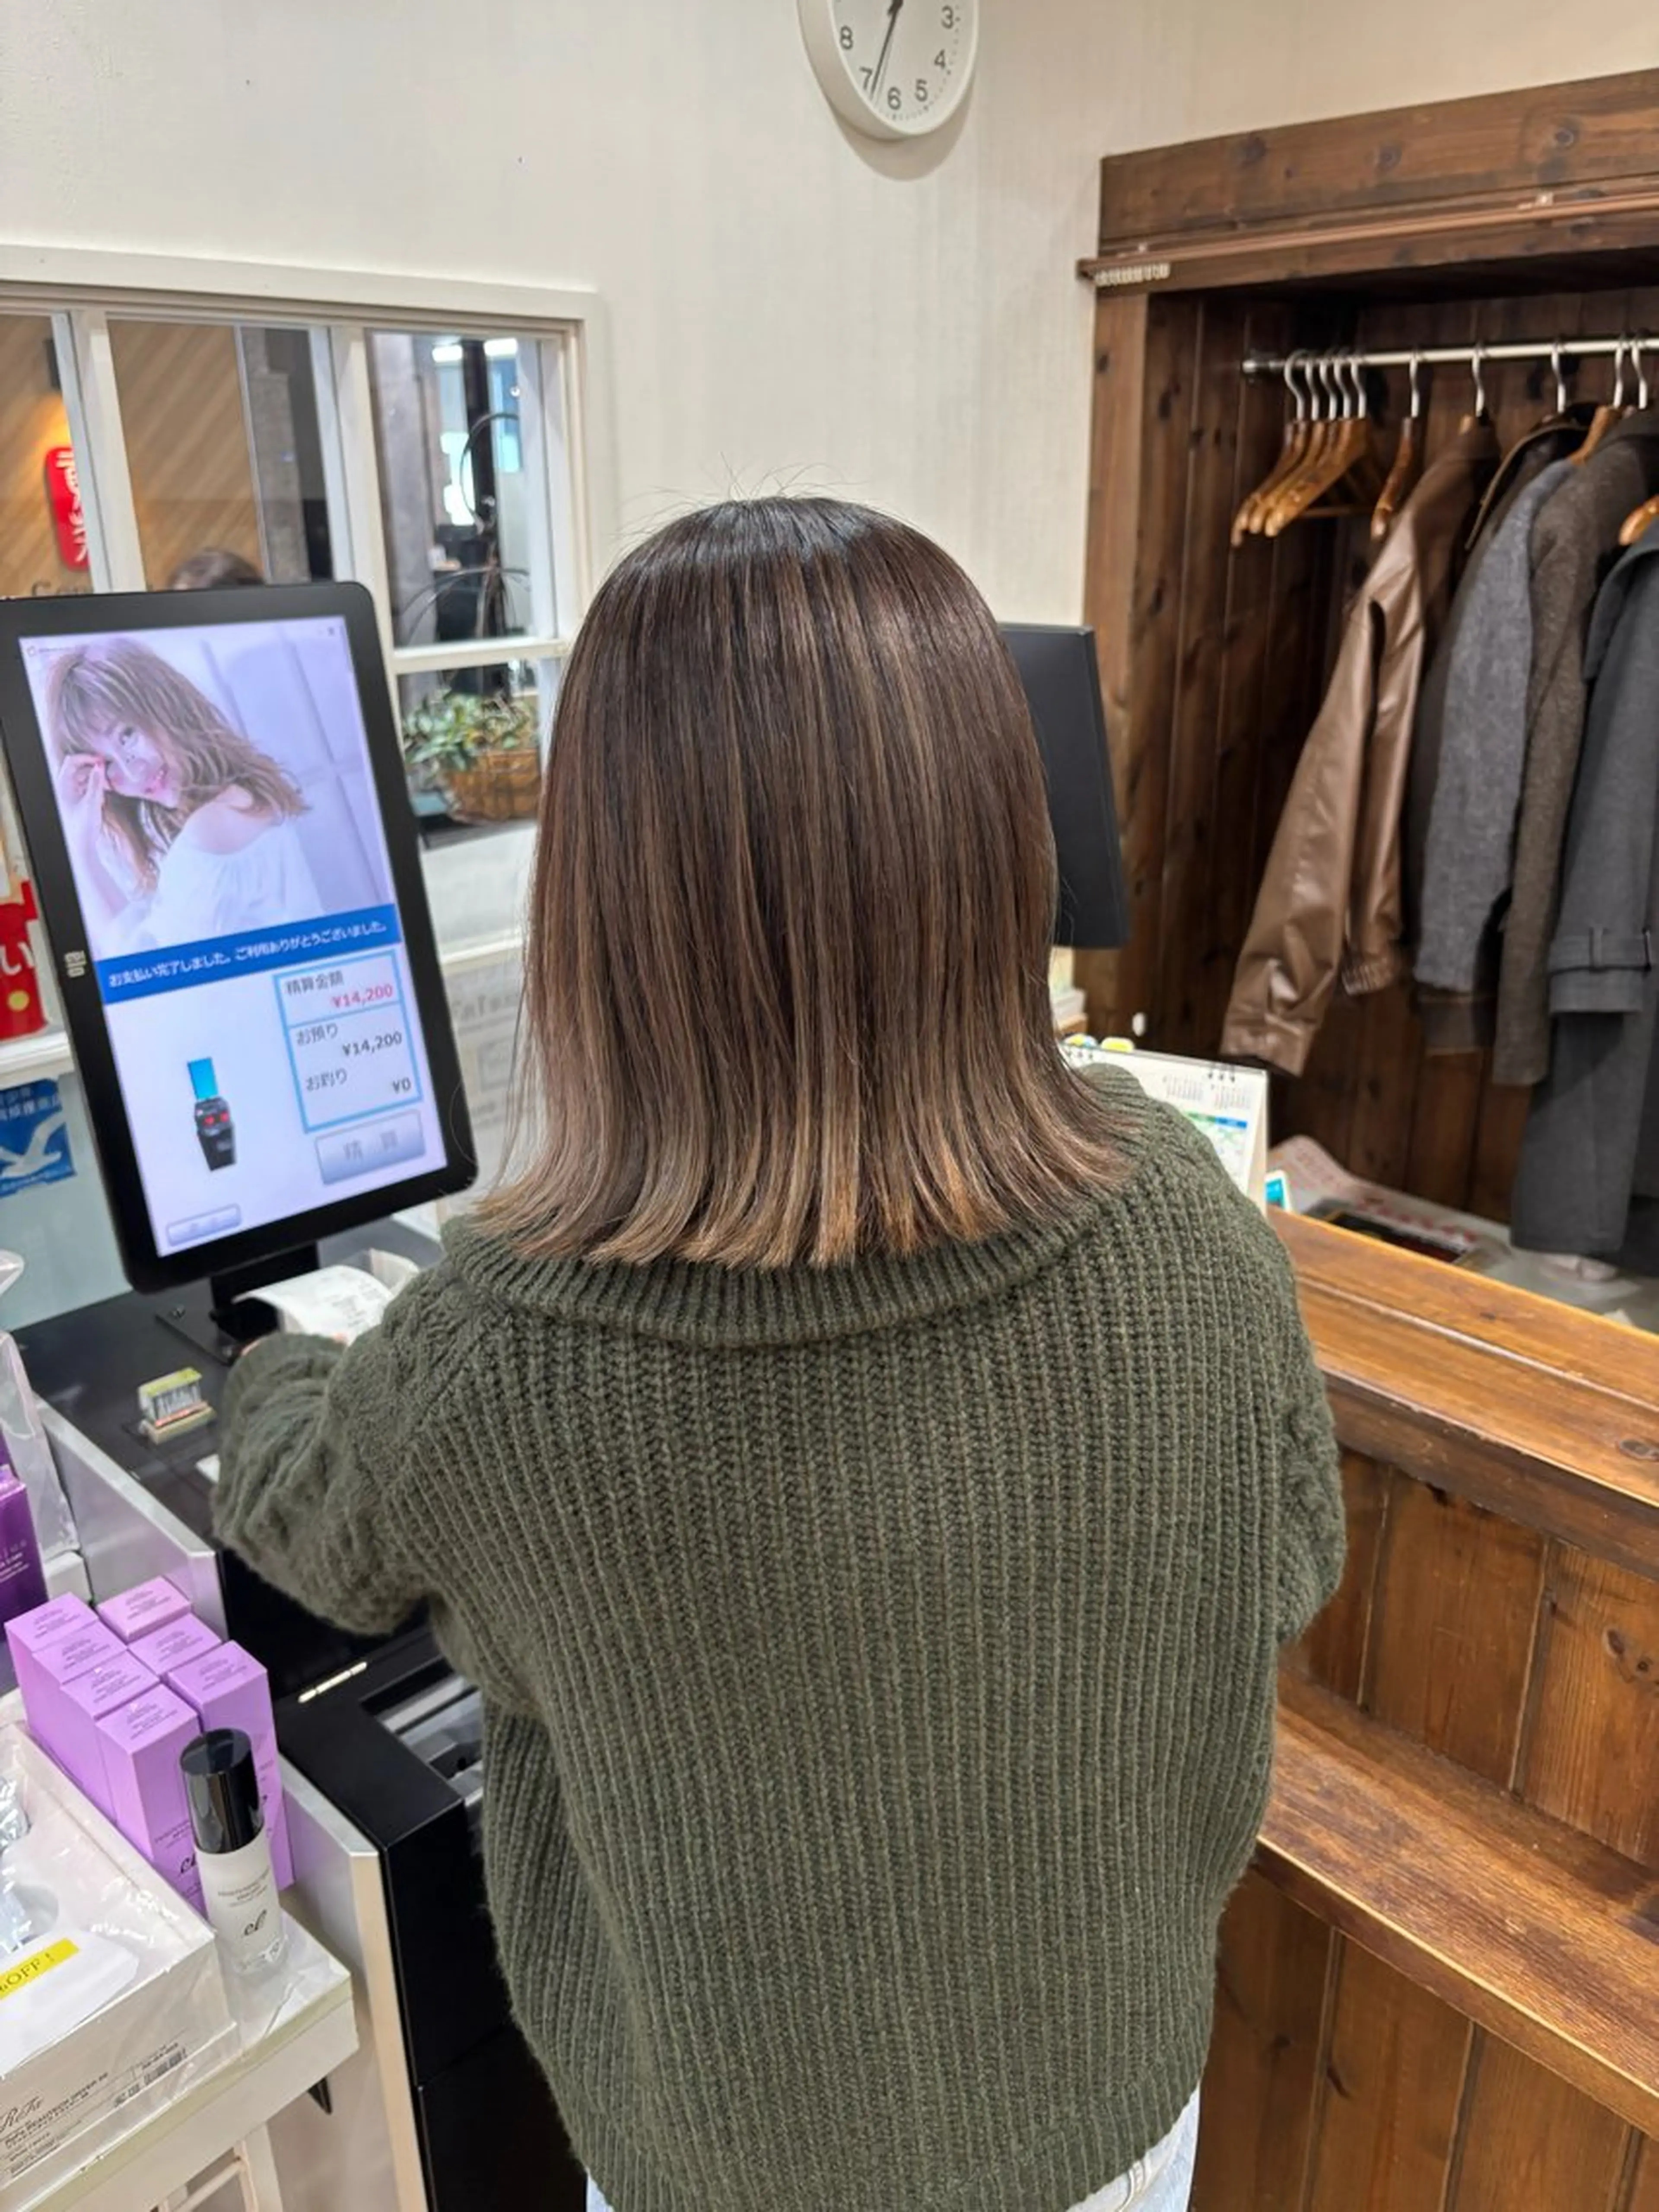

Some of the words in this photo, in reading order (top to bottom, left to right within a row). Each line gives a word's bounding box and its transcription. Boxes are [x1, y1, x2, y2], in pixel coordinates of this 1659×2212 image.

[941, 6, 953, 29] 3
[840, 25, 853, 50] 8
[934, 49, 946, 69] 4
[860, 67, 873, 90] 7
[887, 87, 901, 110] 6
[915, 79, 928, 102] 5
[332, 983, 394, 1008] ¥14,200
[342, 1030, 402, 1056] ¥14,200
[392, 1077, 411, 1094] ¥0
